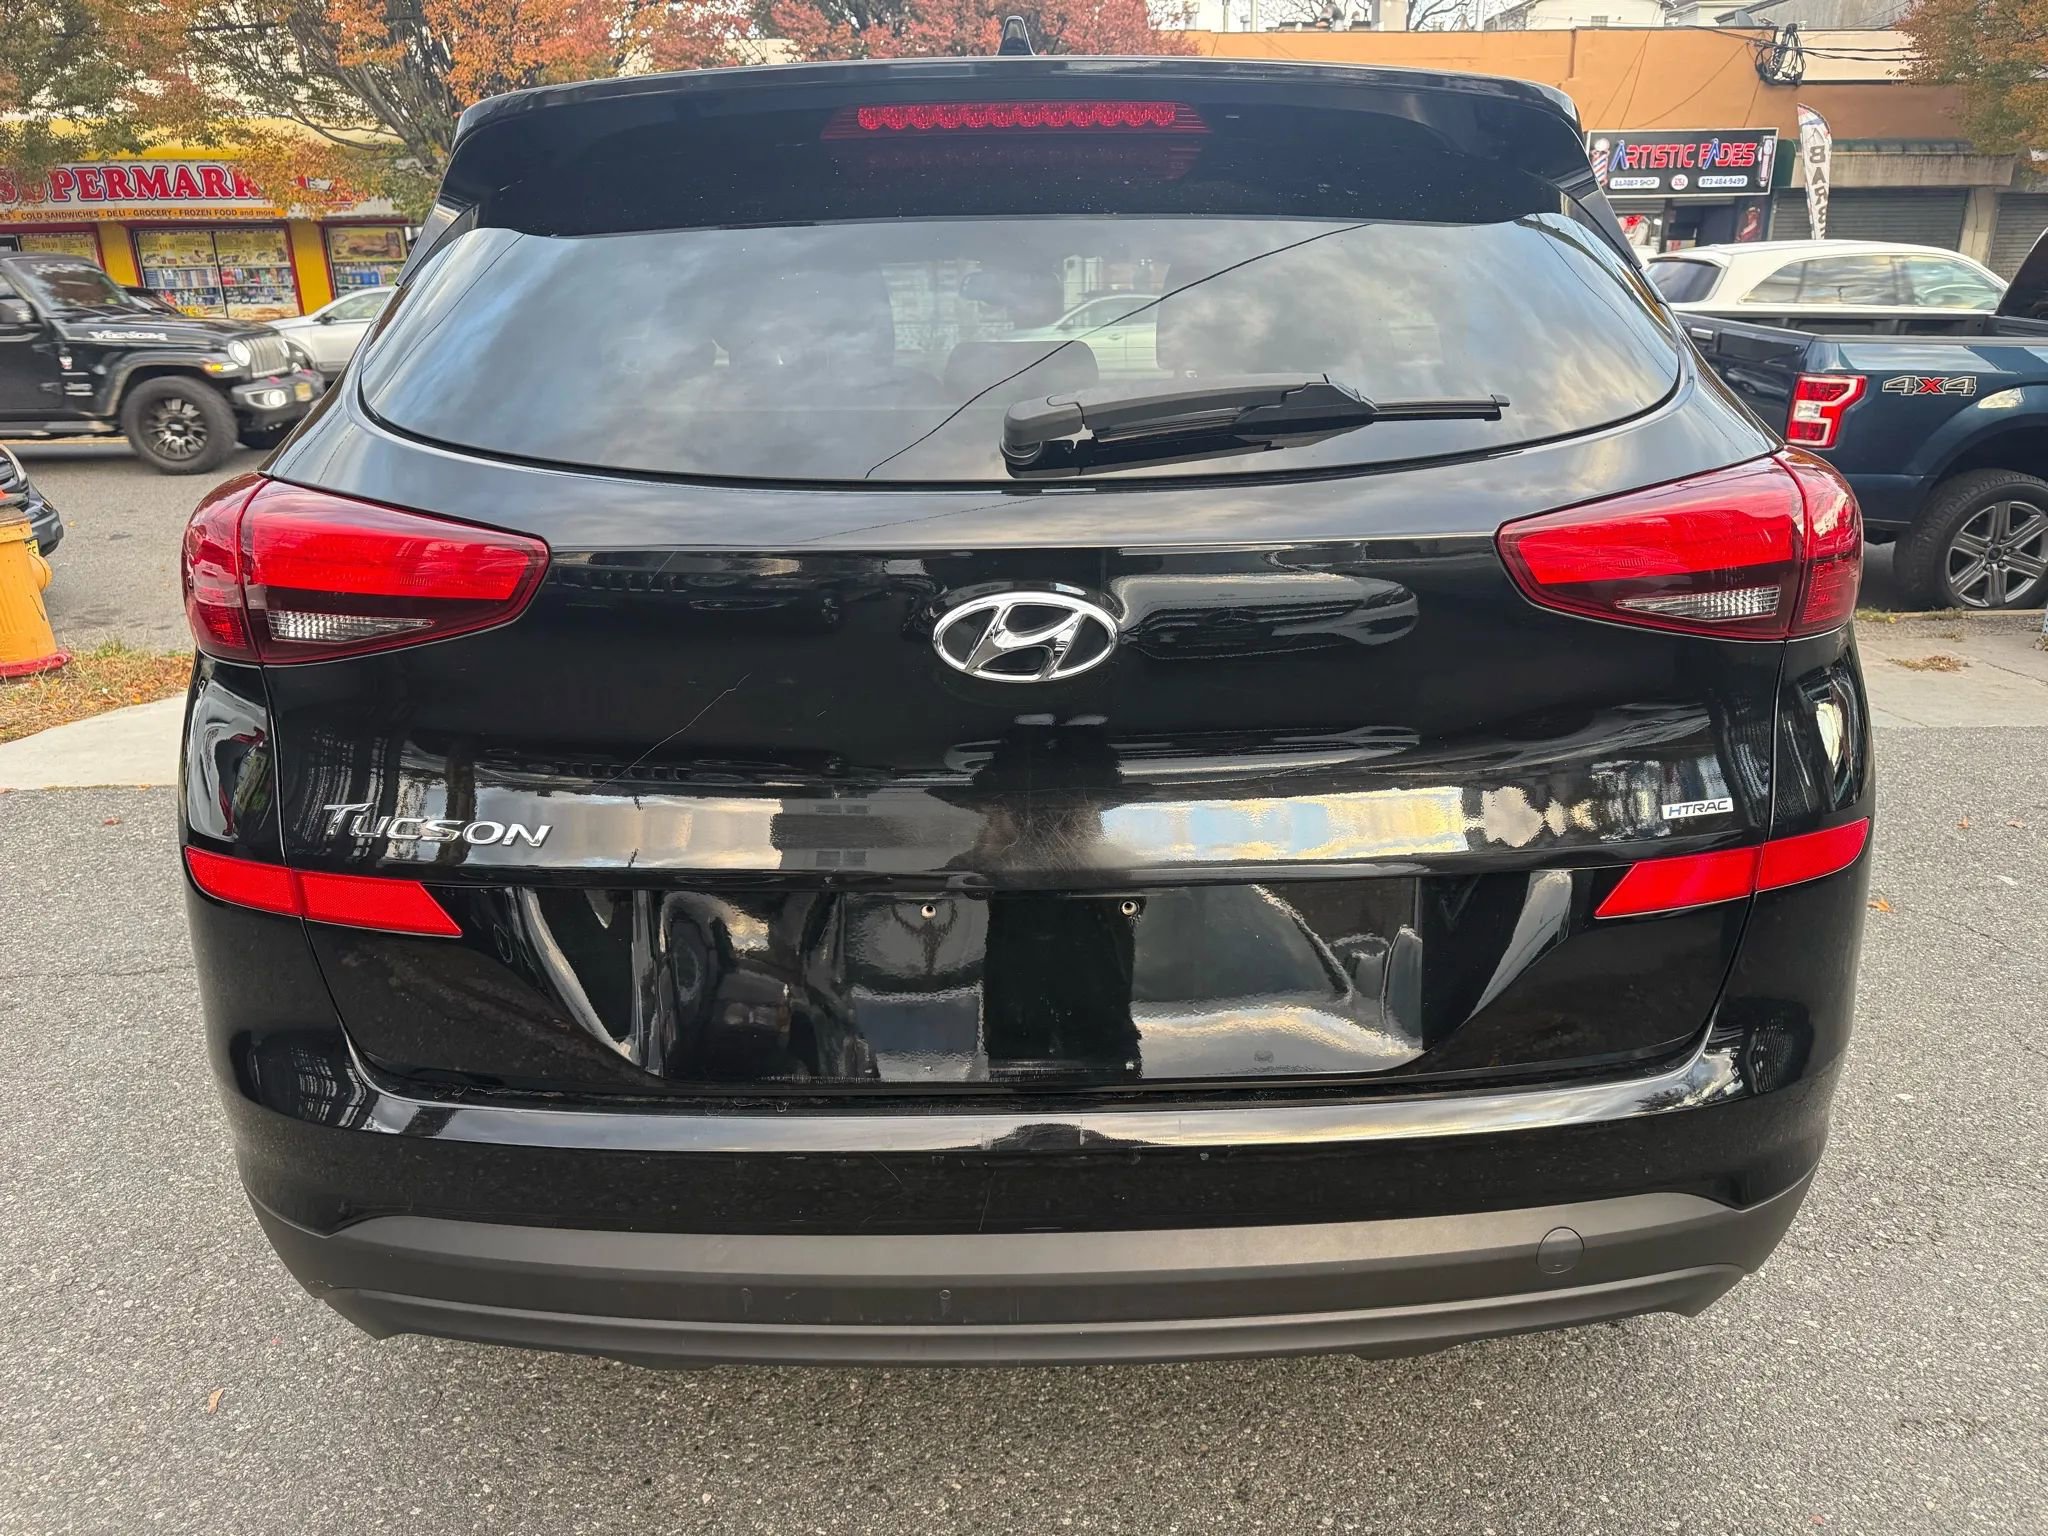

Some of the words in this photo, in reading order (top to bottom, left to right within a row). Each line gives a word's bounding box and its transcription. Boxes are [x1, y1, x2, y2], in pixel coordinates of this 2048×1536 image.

[1609, 138, 1697, 171] ARTISTIC
[1698, 138, 1757, 169] FADES
[20, 212, 42, 220] COLD
[45, 210, 99, 219] SANDWICHES
[133, 209, 172, 217] GROCERY
[180, 208, 212, 217] FROZEN
[214, 208, 238, 216] FOOD
[239, 208, 254, 216] and
[1668, 800, 1729, 816] HTRAC
[323, 802, 553, 848] TUCSON
